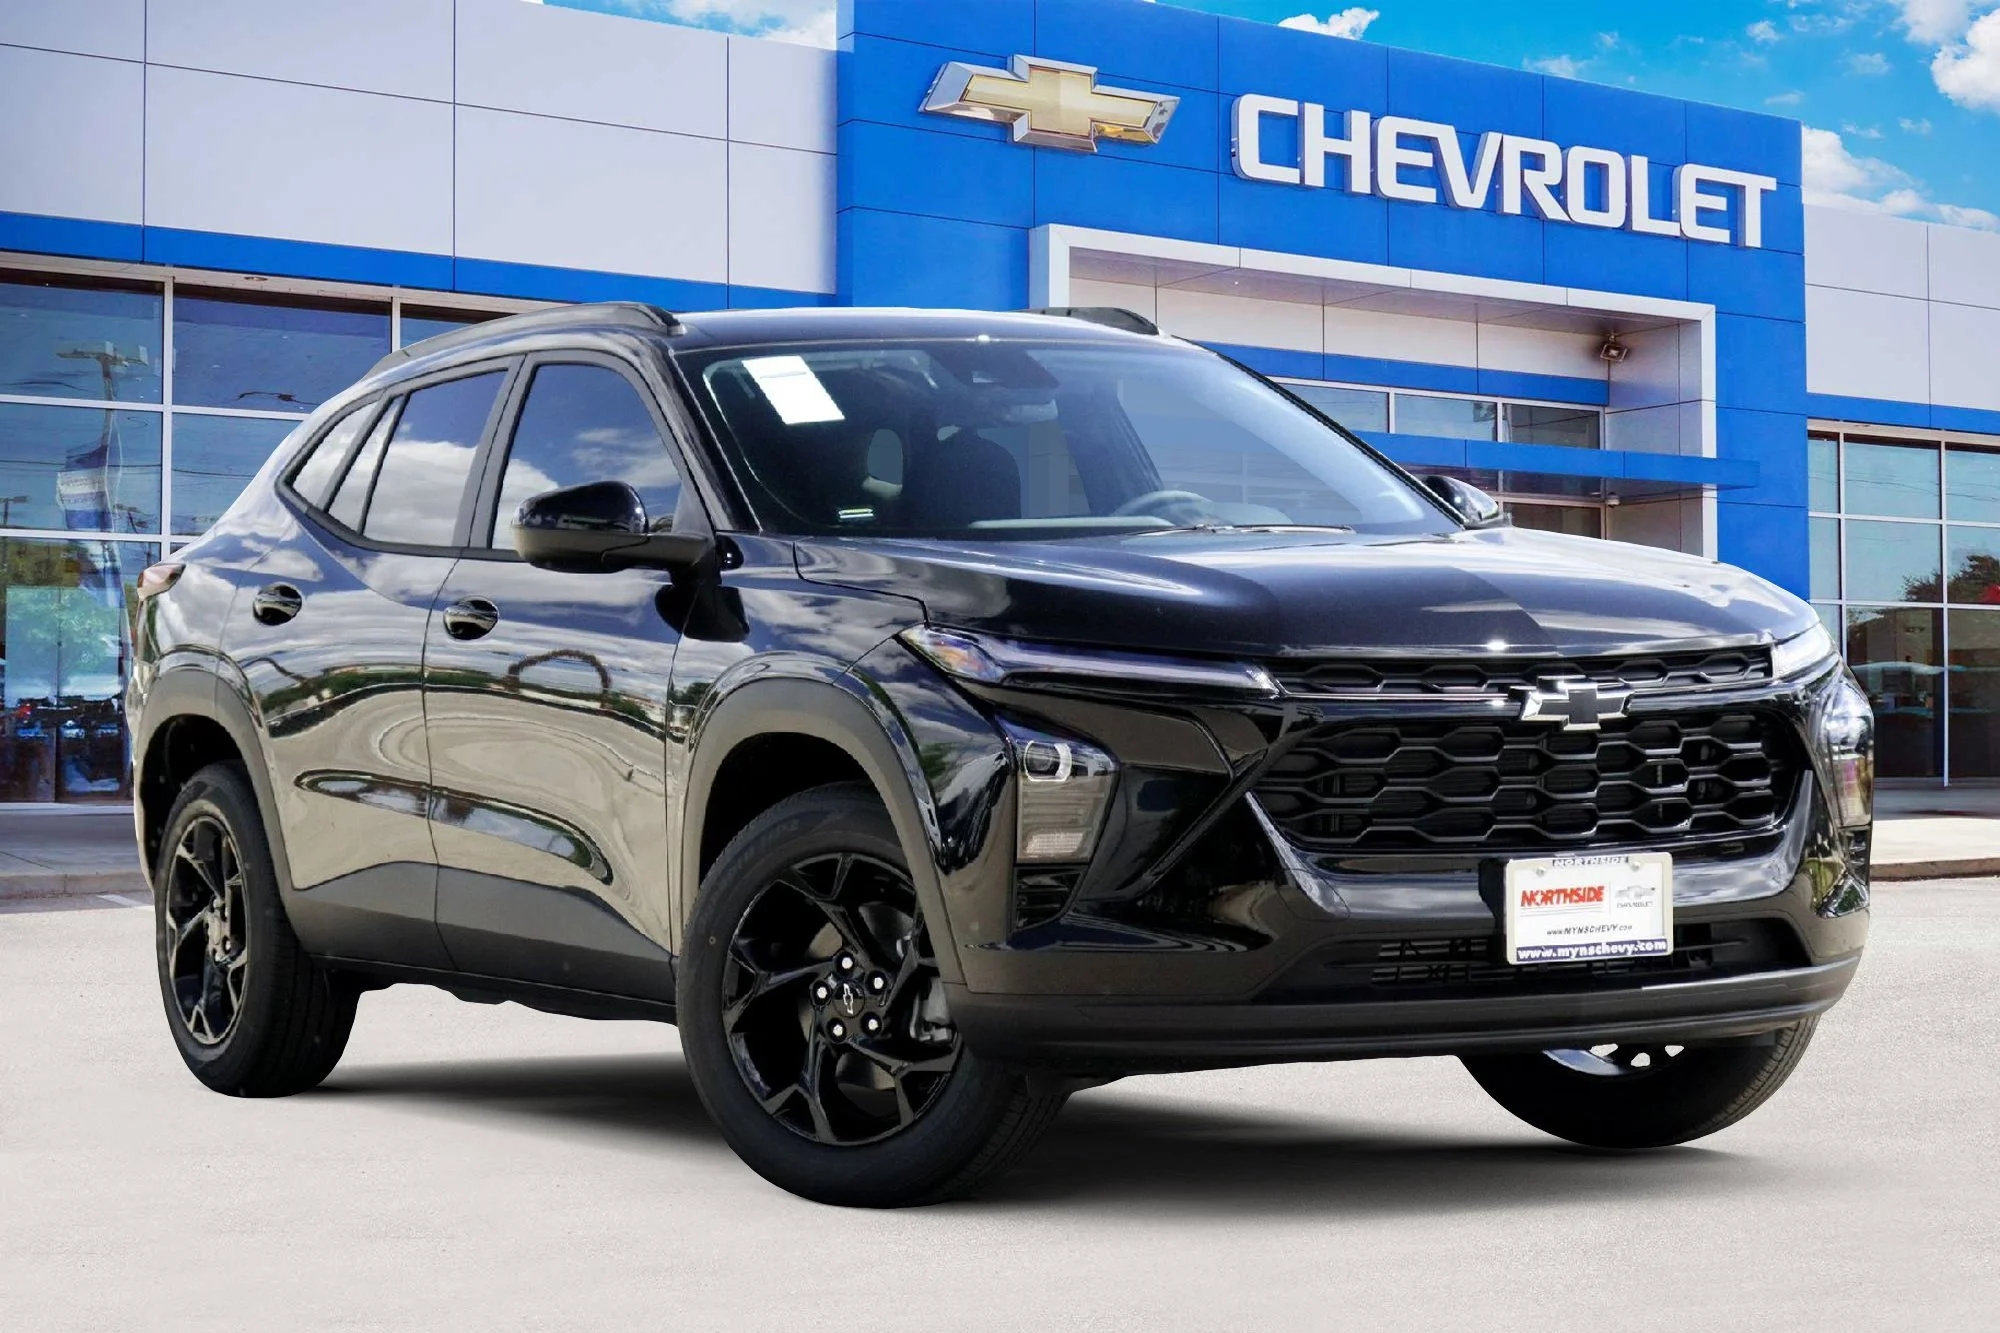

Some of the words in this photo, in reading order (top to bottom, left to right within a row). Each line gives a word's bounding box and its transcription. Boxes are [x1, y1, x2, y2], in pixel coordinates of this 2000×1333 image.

[1230, 93, 1777, 248] CHEVROLET
[1553, 856, 1628, 867] NORTHSIDE
[1520, 885, 1605, 908] NORTHSIDE
[1517, 939, 1667, 961] www.mynschevy.com
